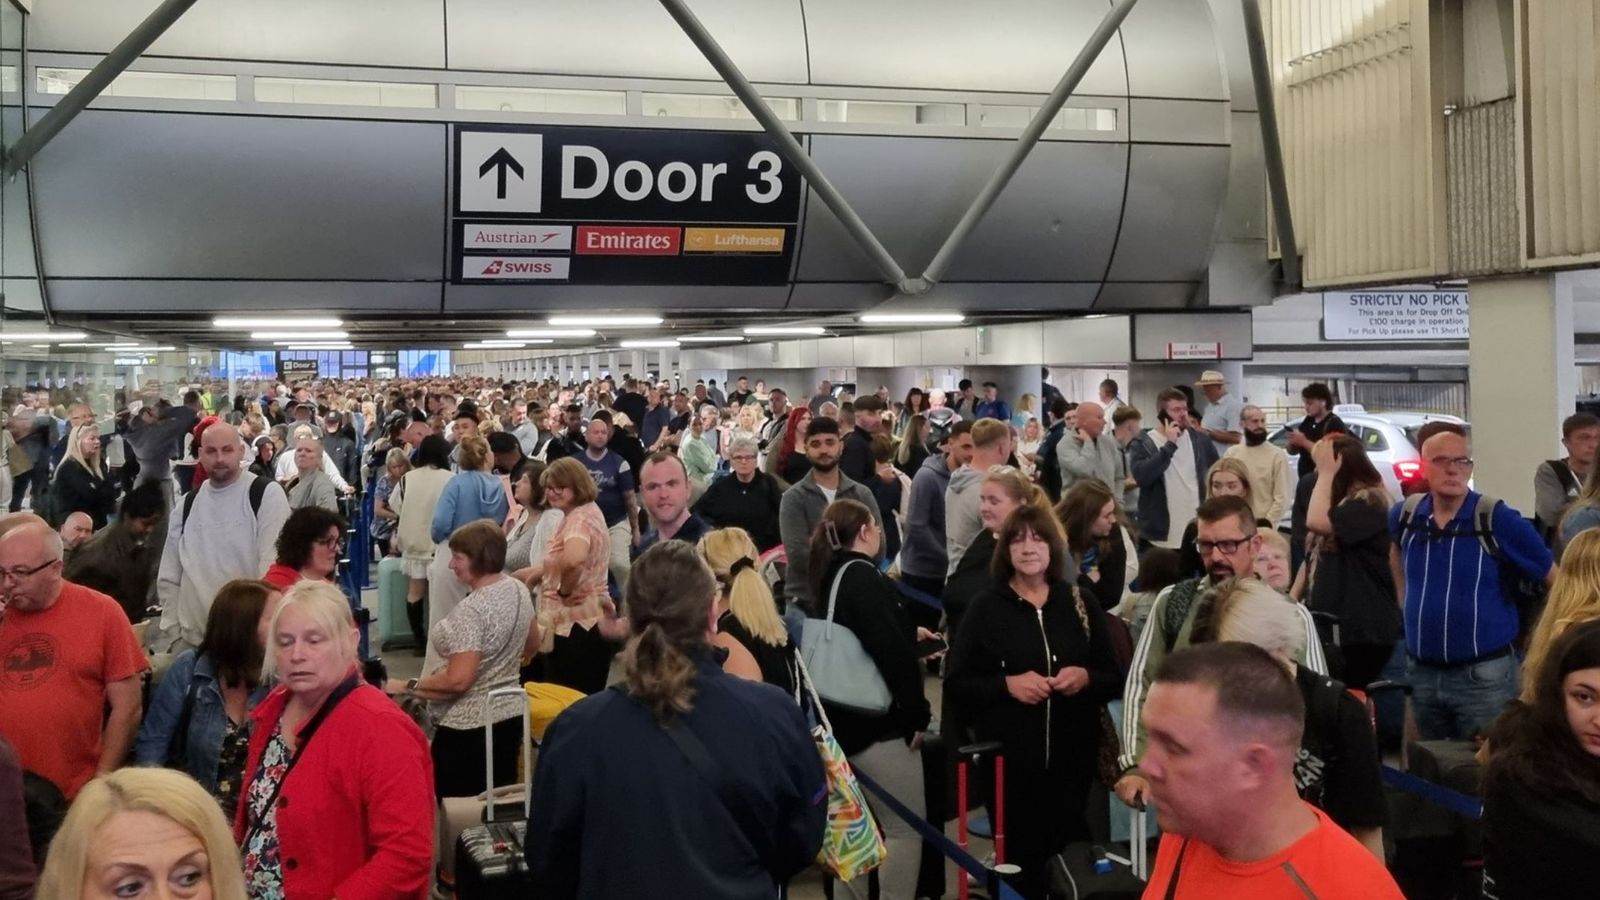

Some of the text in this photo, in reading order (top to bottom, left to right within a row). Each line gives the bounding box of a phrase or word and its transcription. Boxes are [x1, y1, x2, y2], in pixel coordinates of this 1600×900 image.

[560, 144, 784, 204] Door 3
[475, 230, 537, 243] Austrian
[586, 231, 671, 249] Emirates
[714, 234, 780, 246] Lufthansa
[504, 262, 552, 273] SWISS
[1350, 294, 1404, 306] STRICTLY
[1409, 294, 1428, 306] NO
[1433, 294, 1460, 306] PICK
[1358, 308, 1374, 316] This
[1396, 308, 1404, 316] is
[1406, 308, 1417, 316] for
[1420, 308, 1438, 317] Drop
[1441, 307, 1453, 316] Off
[1391, 317, 1416, 327] charge
[1419, 317, 1427, 325] in
[1429, 317, 1464, 326] operation
[1361, 326, 1376, 335] Pick
[1379, 326, 1389, 335] Up
[1391, 326, 1414, 335] please
[1441, 326, 1459, 335] Short
